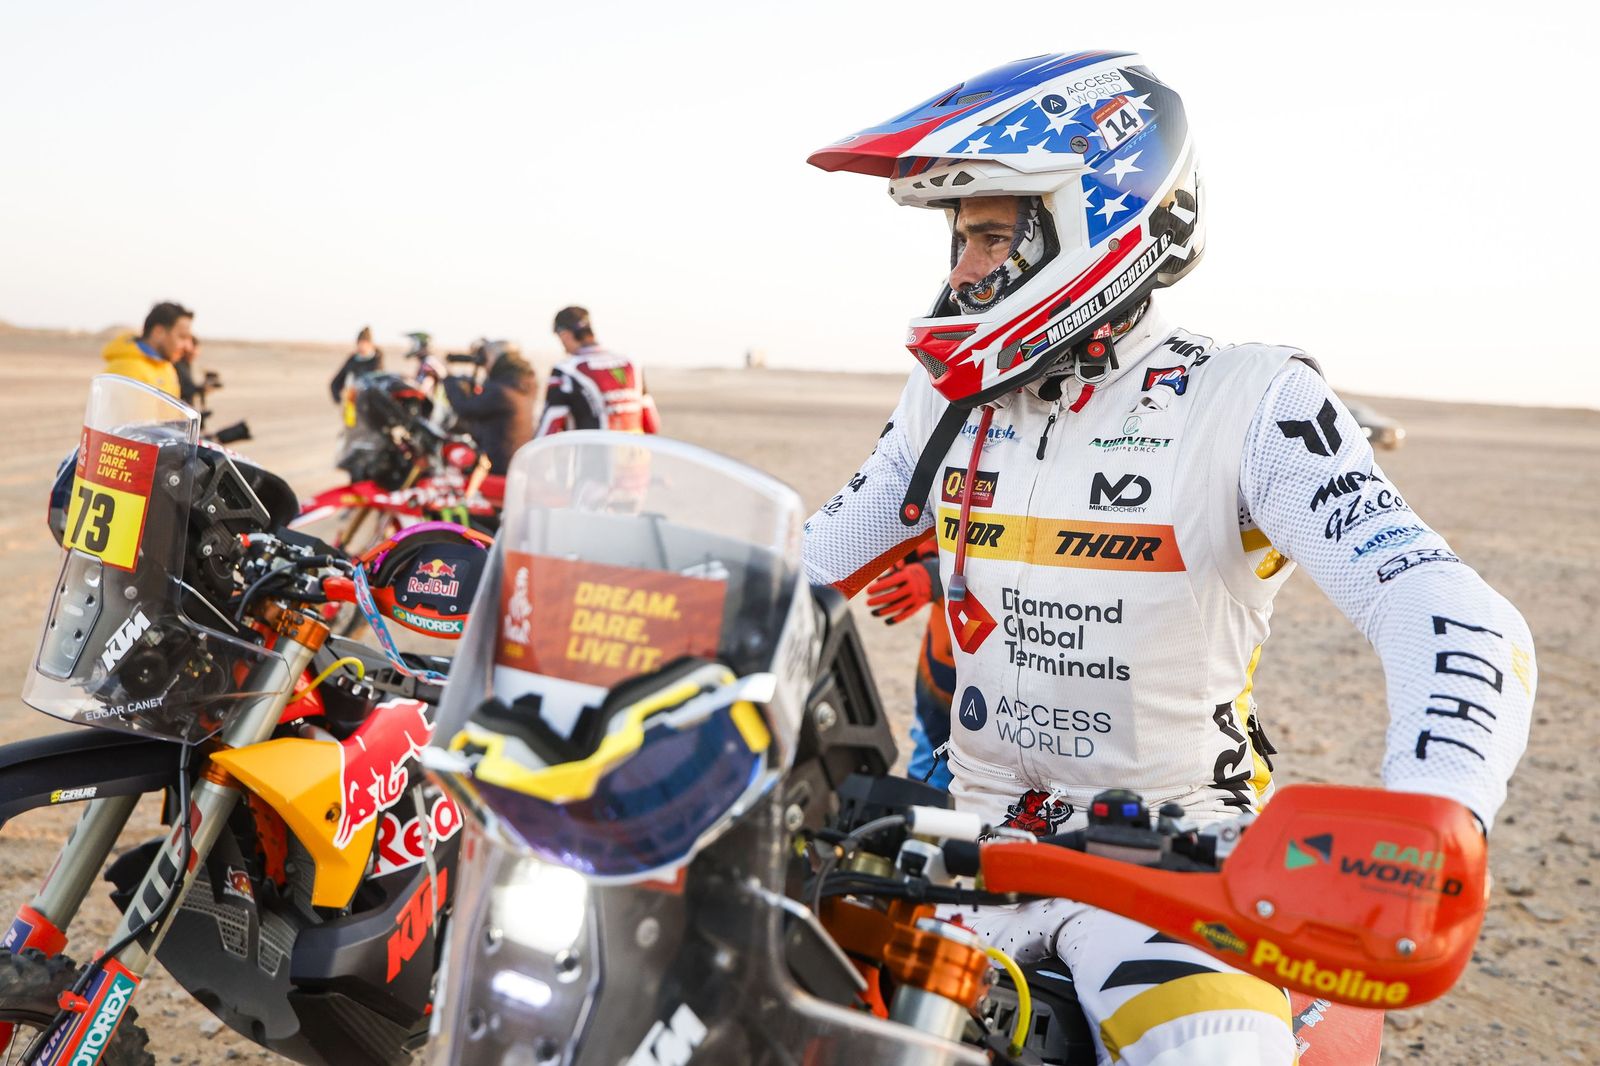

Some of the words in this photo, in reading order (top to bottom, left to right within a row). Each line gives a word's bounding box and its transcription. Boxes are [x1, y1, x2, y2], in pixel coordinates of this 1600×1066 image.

[1065, 71, 1121, 96] ACCESS
[1071, 83, 1122, 105] WORLD
[1105, 108, 1138, 142] 14
[1046, 298, 1104, 345] MICHAEL
[1103, 243, 1161, 308] DOCHERTY
[98, 453, 128, 470] DARE.
[101, 441, 141, 461] DREAM.
[97, 464, 118, 480] LIVE
[118, 471, 132, 483] IT.
[945, 471, 996, 498] QUEN
[70, 485, 116, 553] 73
[1055, 530, 1163, 562] THOR
[574, 581, 682, 620] DREAM.
[1001, 587, 1123, 624] Diamond
[405, 612, 461, 633] MOTOREX
[570, 608, 650, 643] DARE.
[1003, 614, 1084, 650] Global
[101, 610, 152, 673] KTM
[566, 635, 623, 668] LIVE
[1004, 640, 1131, 682] Terminals
[85, 705, 125, 721] EDGAR
[127, 697, 164, 714] CANET
[996, 695, 1112, 734] ACCESS
[996, 719, 1095, 758] WORLD
[50, 786, 98, 804] SCRUB
[373, 787, 464, 879] Red
[1340, 856, 1463, 897] WORLD
[385, 866, 448, 984] KTM
[1252, 938, 1410, 1004] Putoline
[72, 983, 134, 1066] OTOREX
[620, 1002, 708, 1066] TM
